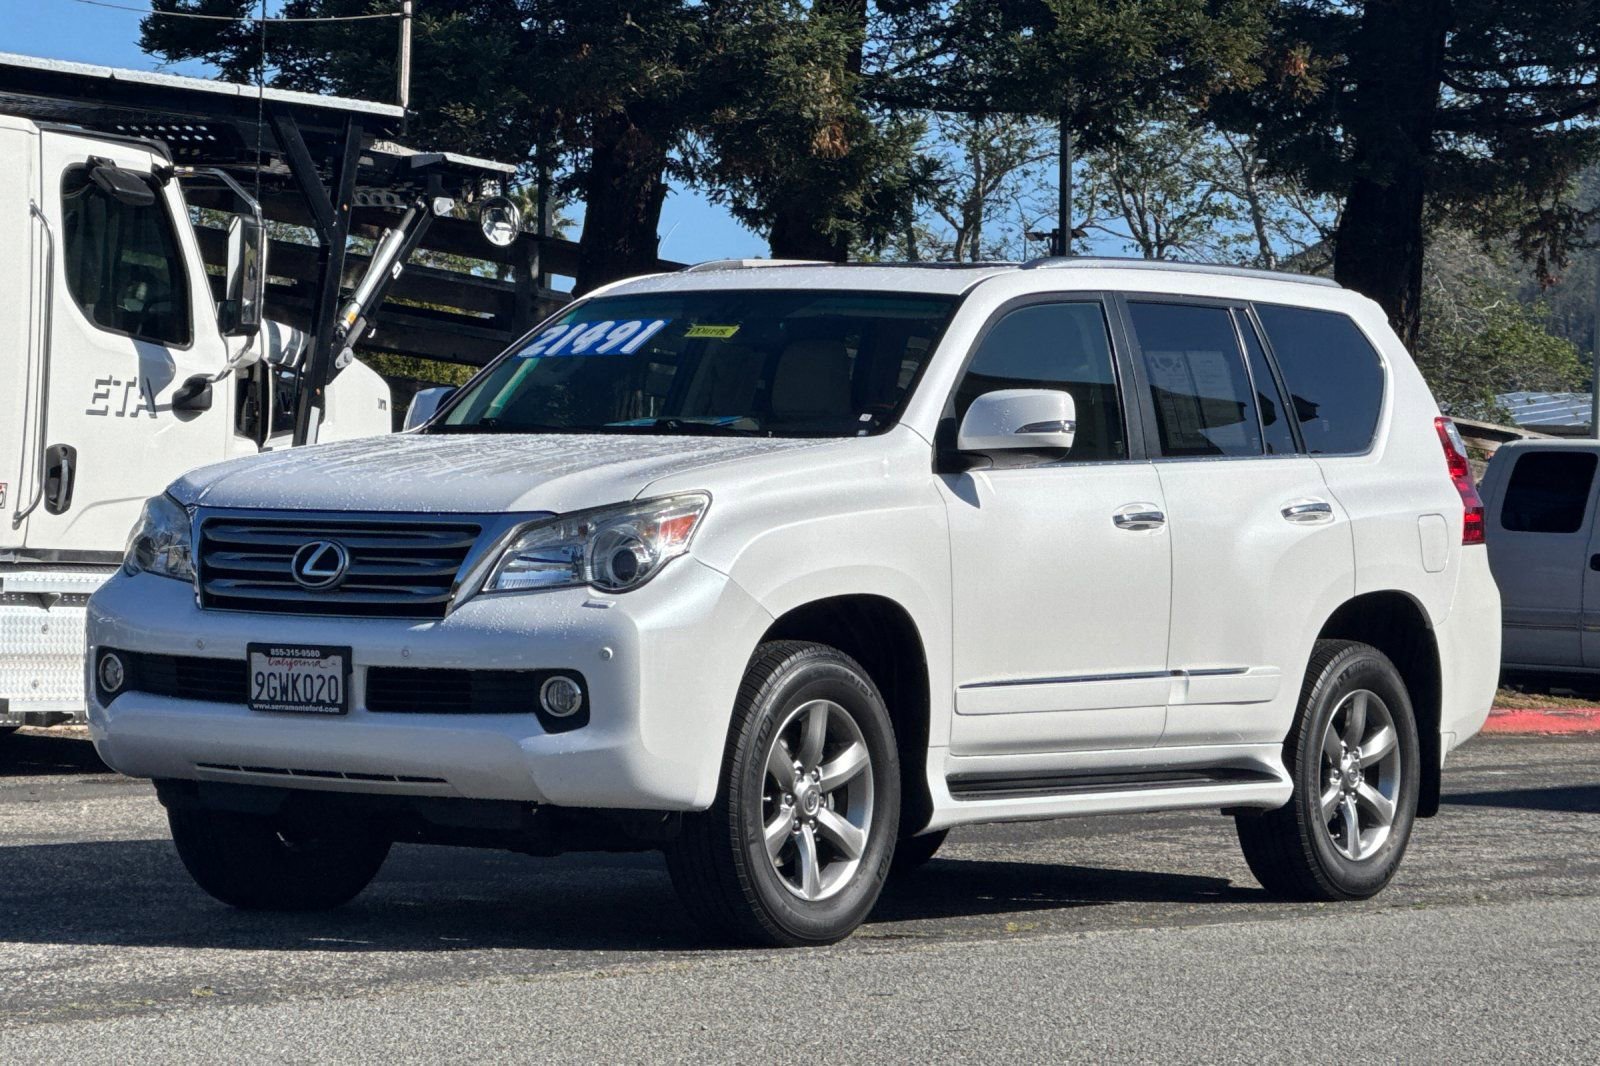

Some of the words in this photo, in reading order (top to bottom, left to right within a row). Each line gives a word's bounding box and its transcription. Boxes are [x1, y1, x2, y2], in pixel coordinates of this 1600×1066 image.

[518, 319, 665, 357] 21491
[86, 375, 157, 419] ETA
[268, 656, 327, 672] California
[270, 648, 321, 658] 855-315-9580
[255, 671, 339, 704] 9GWK020
[252, 702, 340, 713] www.serramonteford.com
